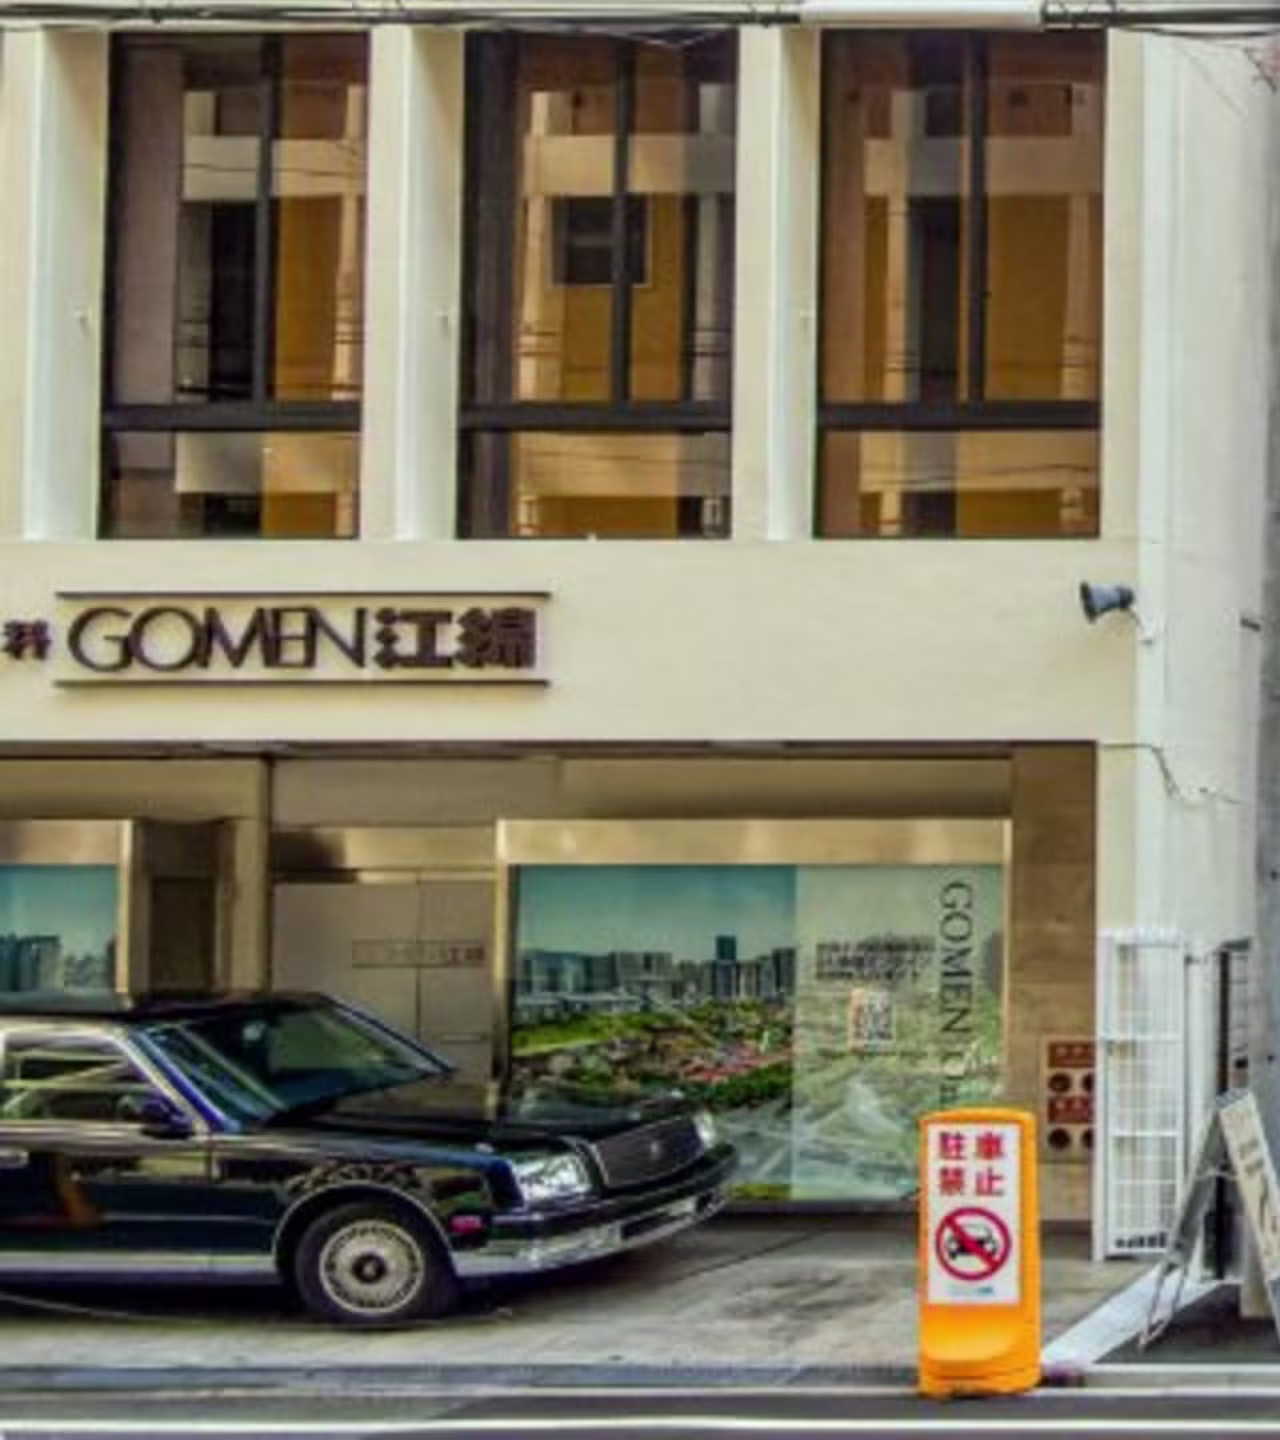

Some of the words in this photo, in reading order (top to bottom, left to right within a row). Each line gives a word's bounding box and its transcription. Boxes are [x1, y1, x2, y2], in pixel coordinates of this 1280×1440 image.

[939, 880, 974, 1034] GOMEN
[938, 1131, 1004, 1161] 駐車
[938, 1166, 1005, 1197] 禁止
